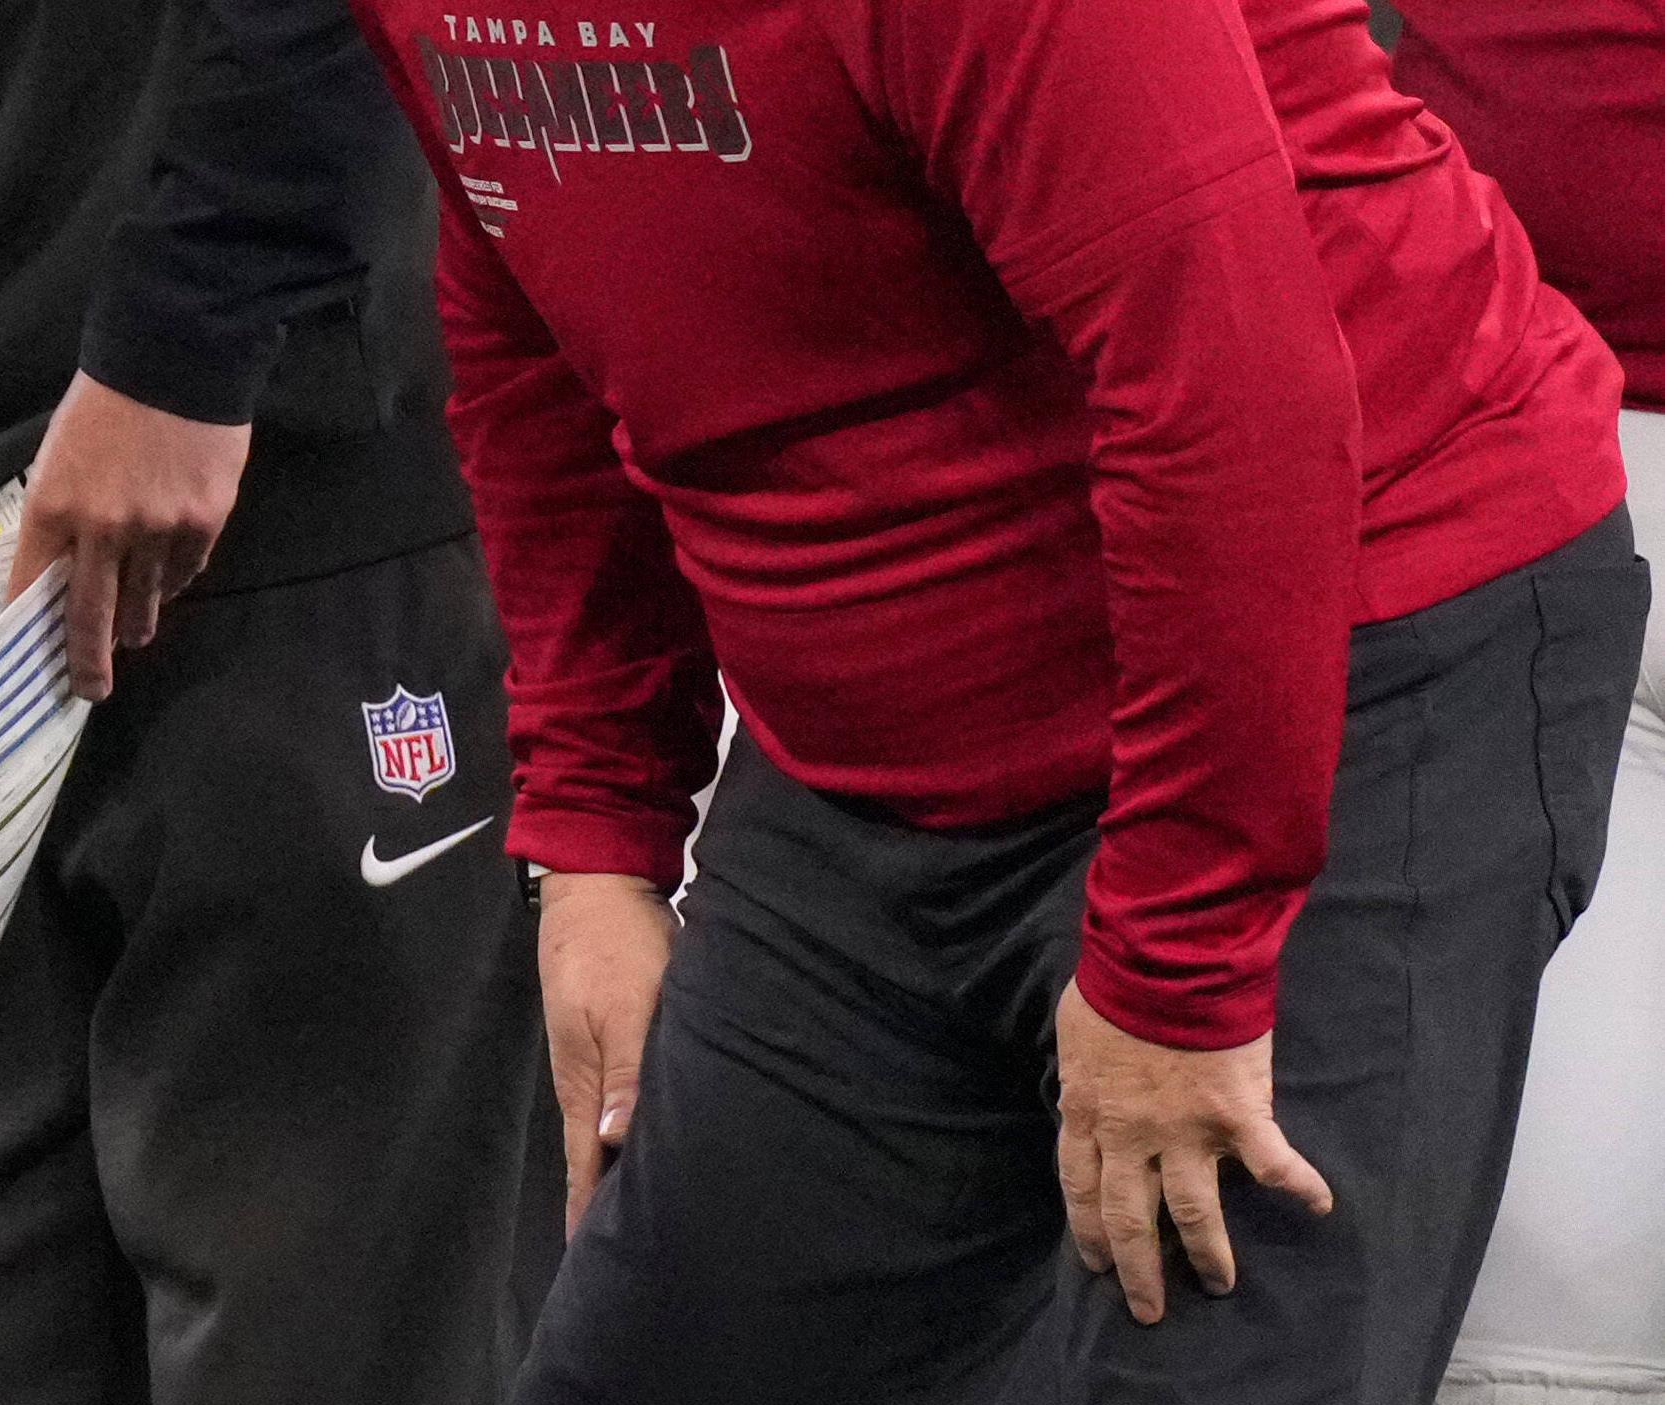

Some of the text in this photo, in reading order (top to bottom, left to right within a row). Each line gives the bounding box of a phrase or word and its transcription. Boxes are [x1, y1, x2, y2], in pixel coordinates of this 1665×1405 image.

[444, 14, 655, 48] TAMPA BAY
[380, 733, 446, 782] NFL
